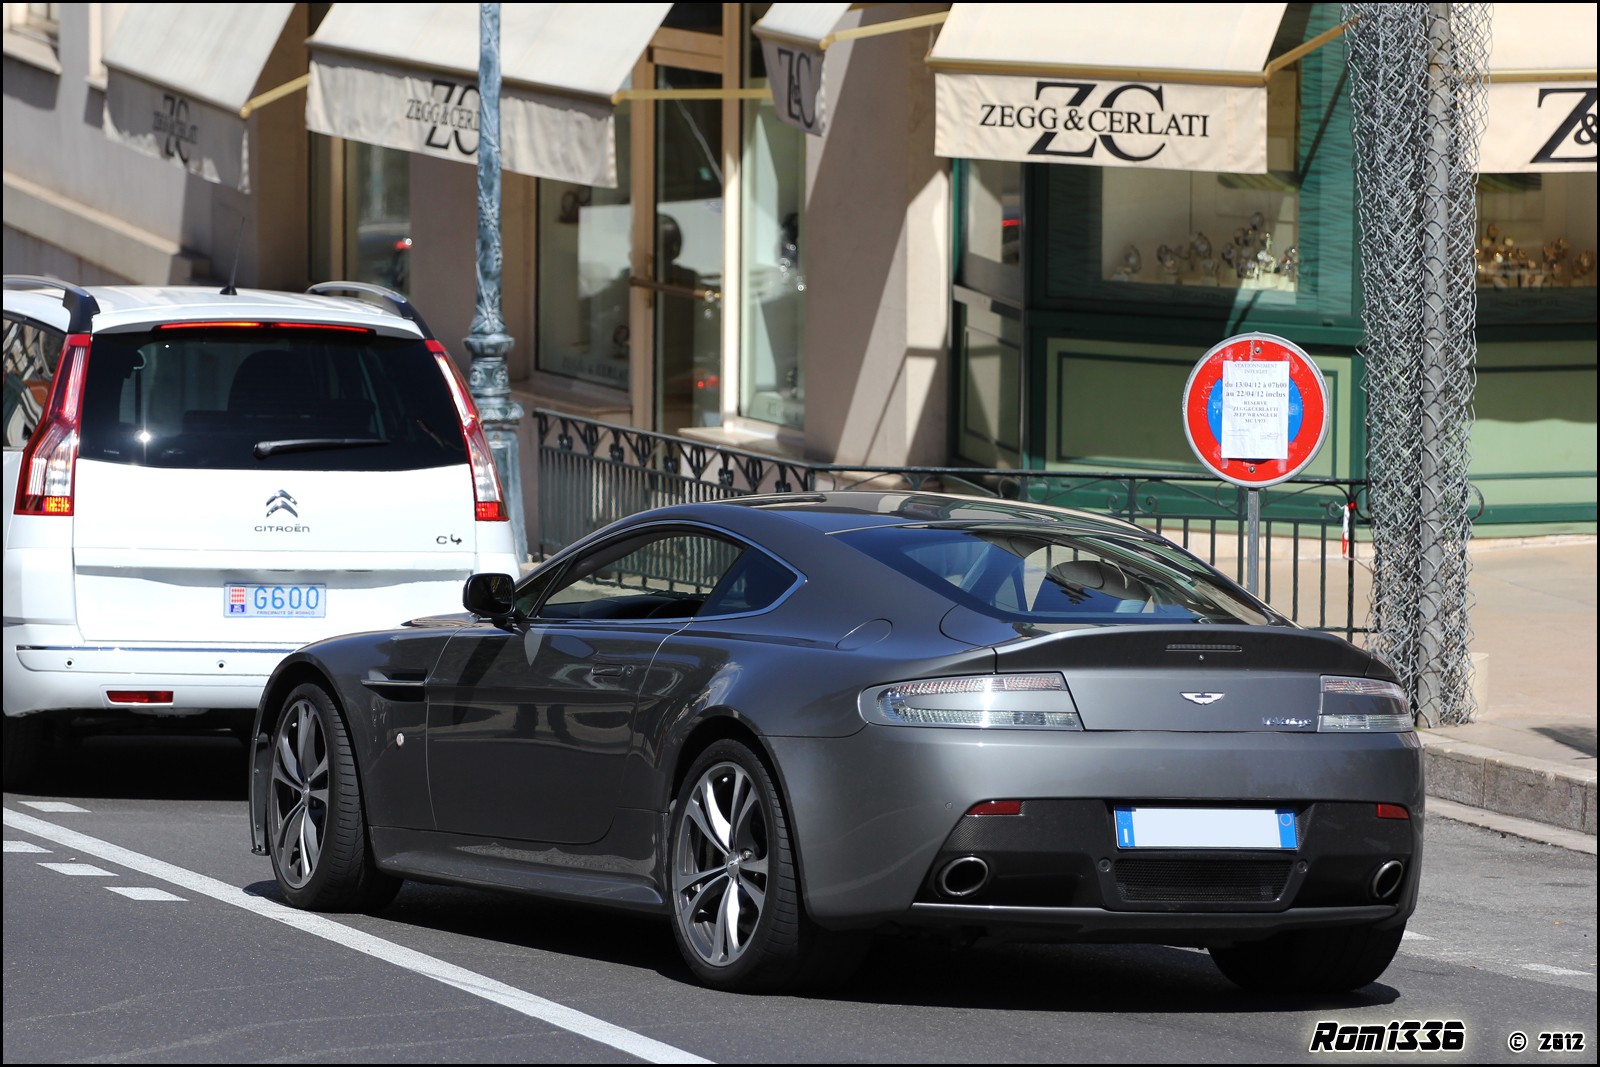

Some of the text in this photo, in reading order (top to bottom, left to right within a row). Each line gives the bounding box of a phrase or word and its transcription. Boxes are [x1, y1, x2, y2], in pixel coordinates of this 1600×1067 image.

[405, 98, 480, 132] ZEGG&CERL
[1027, 81, 1166, 162] ZC
[1268, 381, 1287, 389] 07h00
[1265, 390, 1286, 398] inclus
[254, 523, 310, 533] CITROËN
[253, 586, 319, 610] G600
